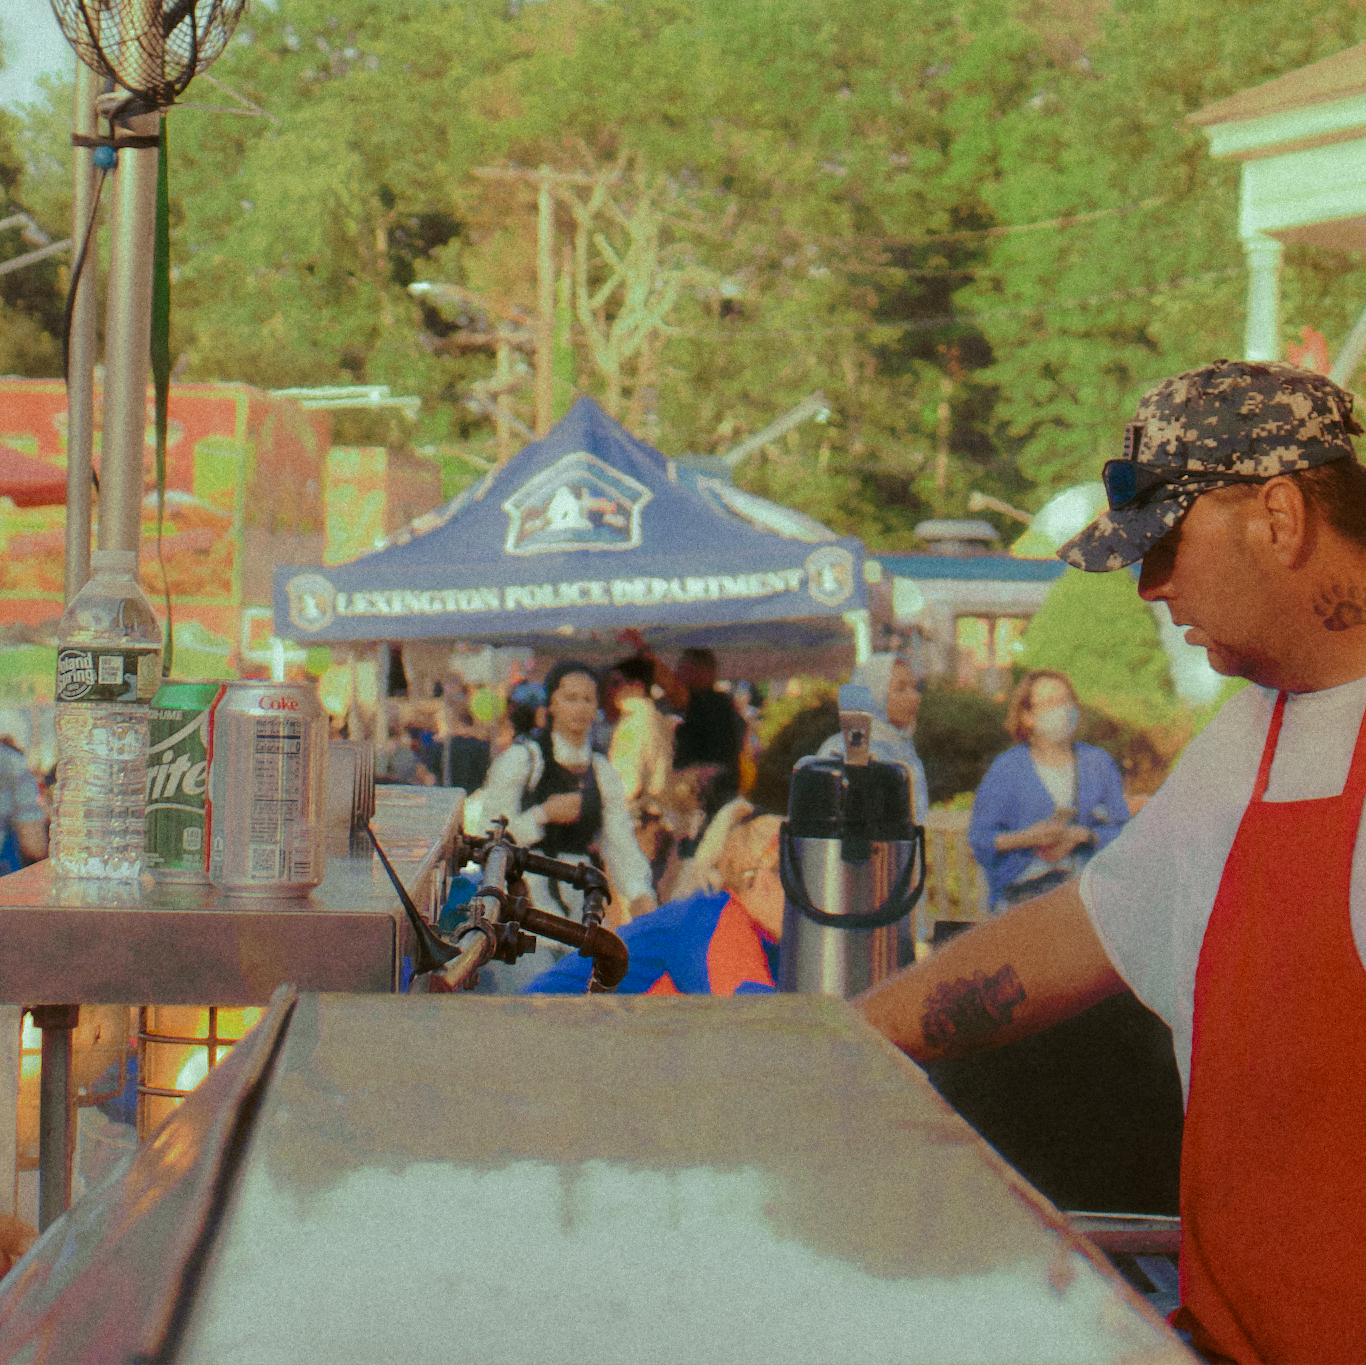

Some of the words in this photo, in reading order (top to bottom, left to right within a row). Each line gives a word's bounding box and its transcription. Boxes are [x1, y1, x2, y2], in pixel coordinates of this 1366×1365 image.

[336, 586, 501, 616] LEXINGTON
[503, 579, 609, 611] POLICE
[609, 567, 805, 607] DEPARTMENT
[259, 695, 299, 711] Coke
[145, 748, 207, 802] rite
